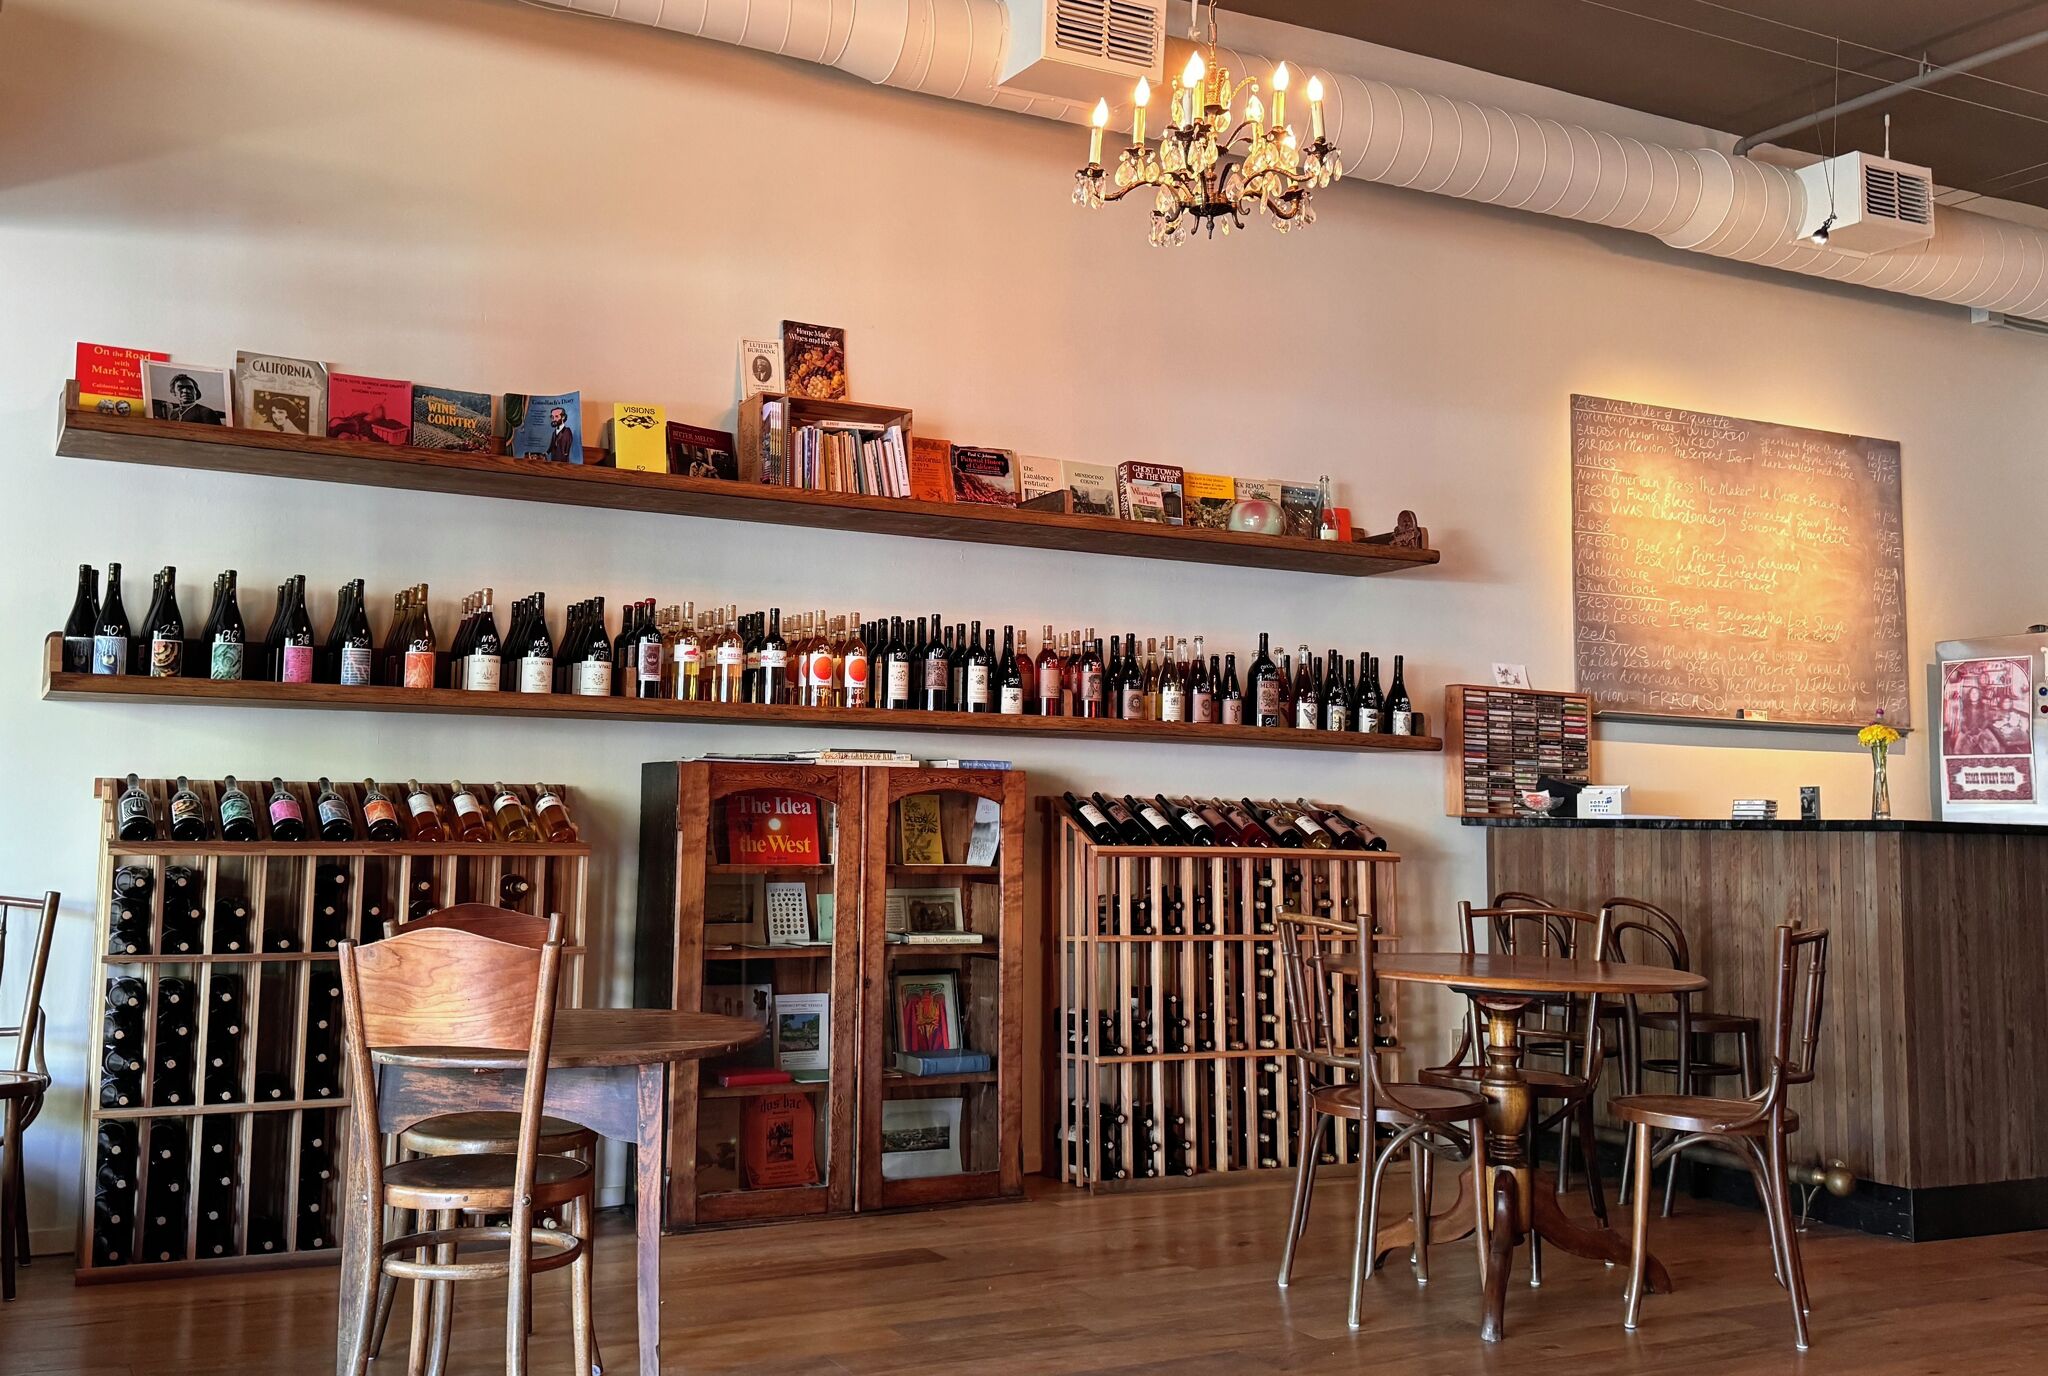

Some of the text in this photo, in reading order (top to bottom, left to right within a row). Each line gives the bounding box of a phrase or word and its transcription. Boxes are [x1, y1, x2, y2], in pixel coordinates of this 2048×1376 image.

[94, 346, 151, 361] On the Road
[91, 365, 141, 378] Mark Twa
[252, 360, 312, 379] CALIFORNIA
[427, 402, 456, 415] WINE
[623, 406, 655, 415] VISIONS
[427, 414, 477, 429] COUNTRY
[1679, 411, 1731, 429] Piquette
[1576, 453, 1617, 469] Whites
[1074, 472, 1104, 480] MENDOCINO
[1132, 464, 1181, 477] GHOST TOWNS
[1135, 471, 1143, 479] OF
[1160, 475, 1178, 483] WEST
[1577, 469, 1609, 482] North
[1611, 471, 1662, 490] American
[1576, 514, 1612, 533] Rosé
[1651, 503, 1727, 547] Chardonnay
[1668, 542, 1684, 557] of
[1576, 560, 1606, 578] Caleb
[1607, 563, 1652, 582] Leisure
[1696, 576, 1737, 590] Under
[1576, 577, 1657, 597] Skin Contact
[1577, 595, 1634, 611] FRES.CO
[1577, 606, 1610, 623] Caleb
[1613, 609, 1663, 628] Leisure
[1682, 617, 1711, 634] Got
[1717, 621, 1737, 635] It
[103, 624, 119, 636] 40
[1577, 624, 1617, 643] Reds
[481, 634, 497, 643] NEW
[533, 639, 550, 647] NEW
[1578, 655, 1619, 668] Caleb
[1623, 657, 1674, 671] Leisure
[1754, 663, 1797, 677] Merlot
[1580, 669, 1616, 682] North
[1619, 669, 1686, 687] American
[1687, 673, 1721, 692] Press
[1838, 680, 1872, 695] Wine
[1232, 691, 1240, 700] 15
[1743, 694, 1790, 712] Sonoma
[1793, 698, 1818, 714] Red
[1821, 697, 1858, 715] Blend
[1964, 772, 2016, 785] HOME SWEET HOME
[736, 795, 812, 815] The Idea
[740, 834, 812, 854] the West
